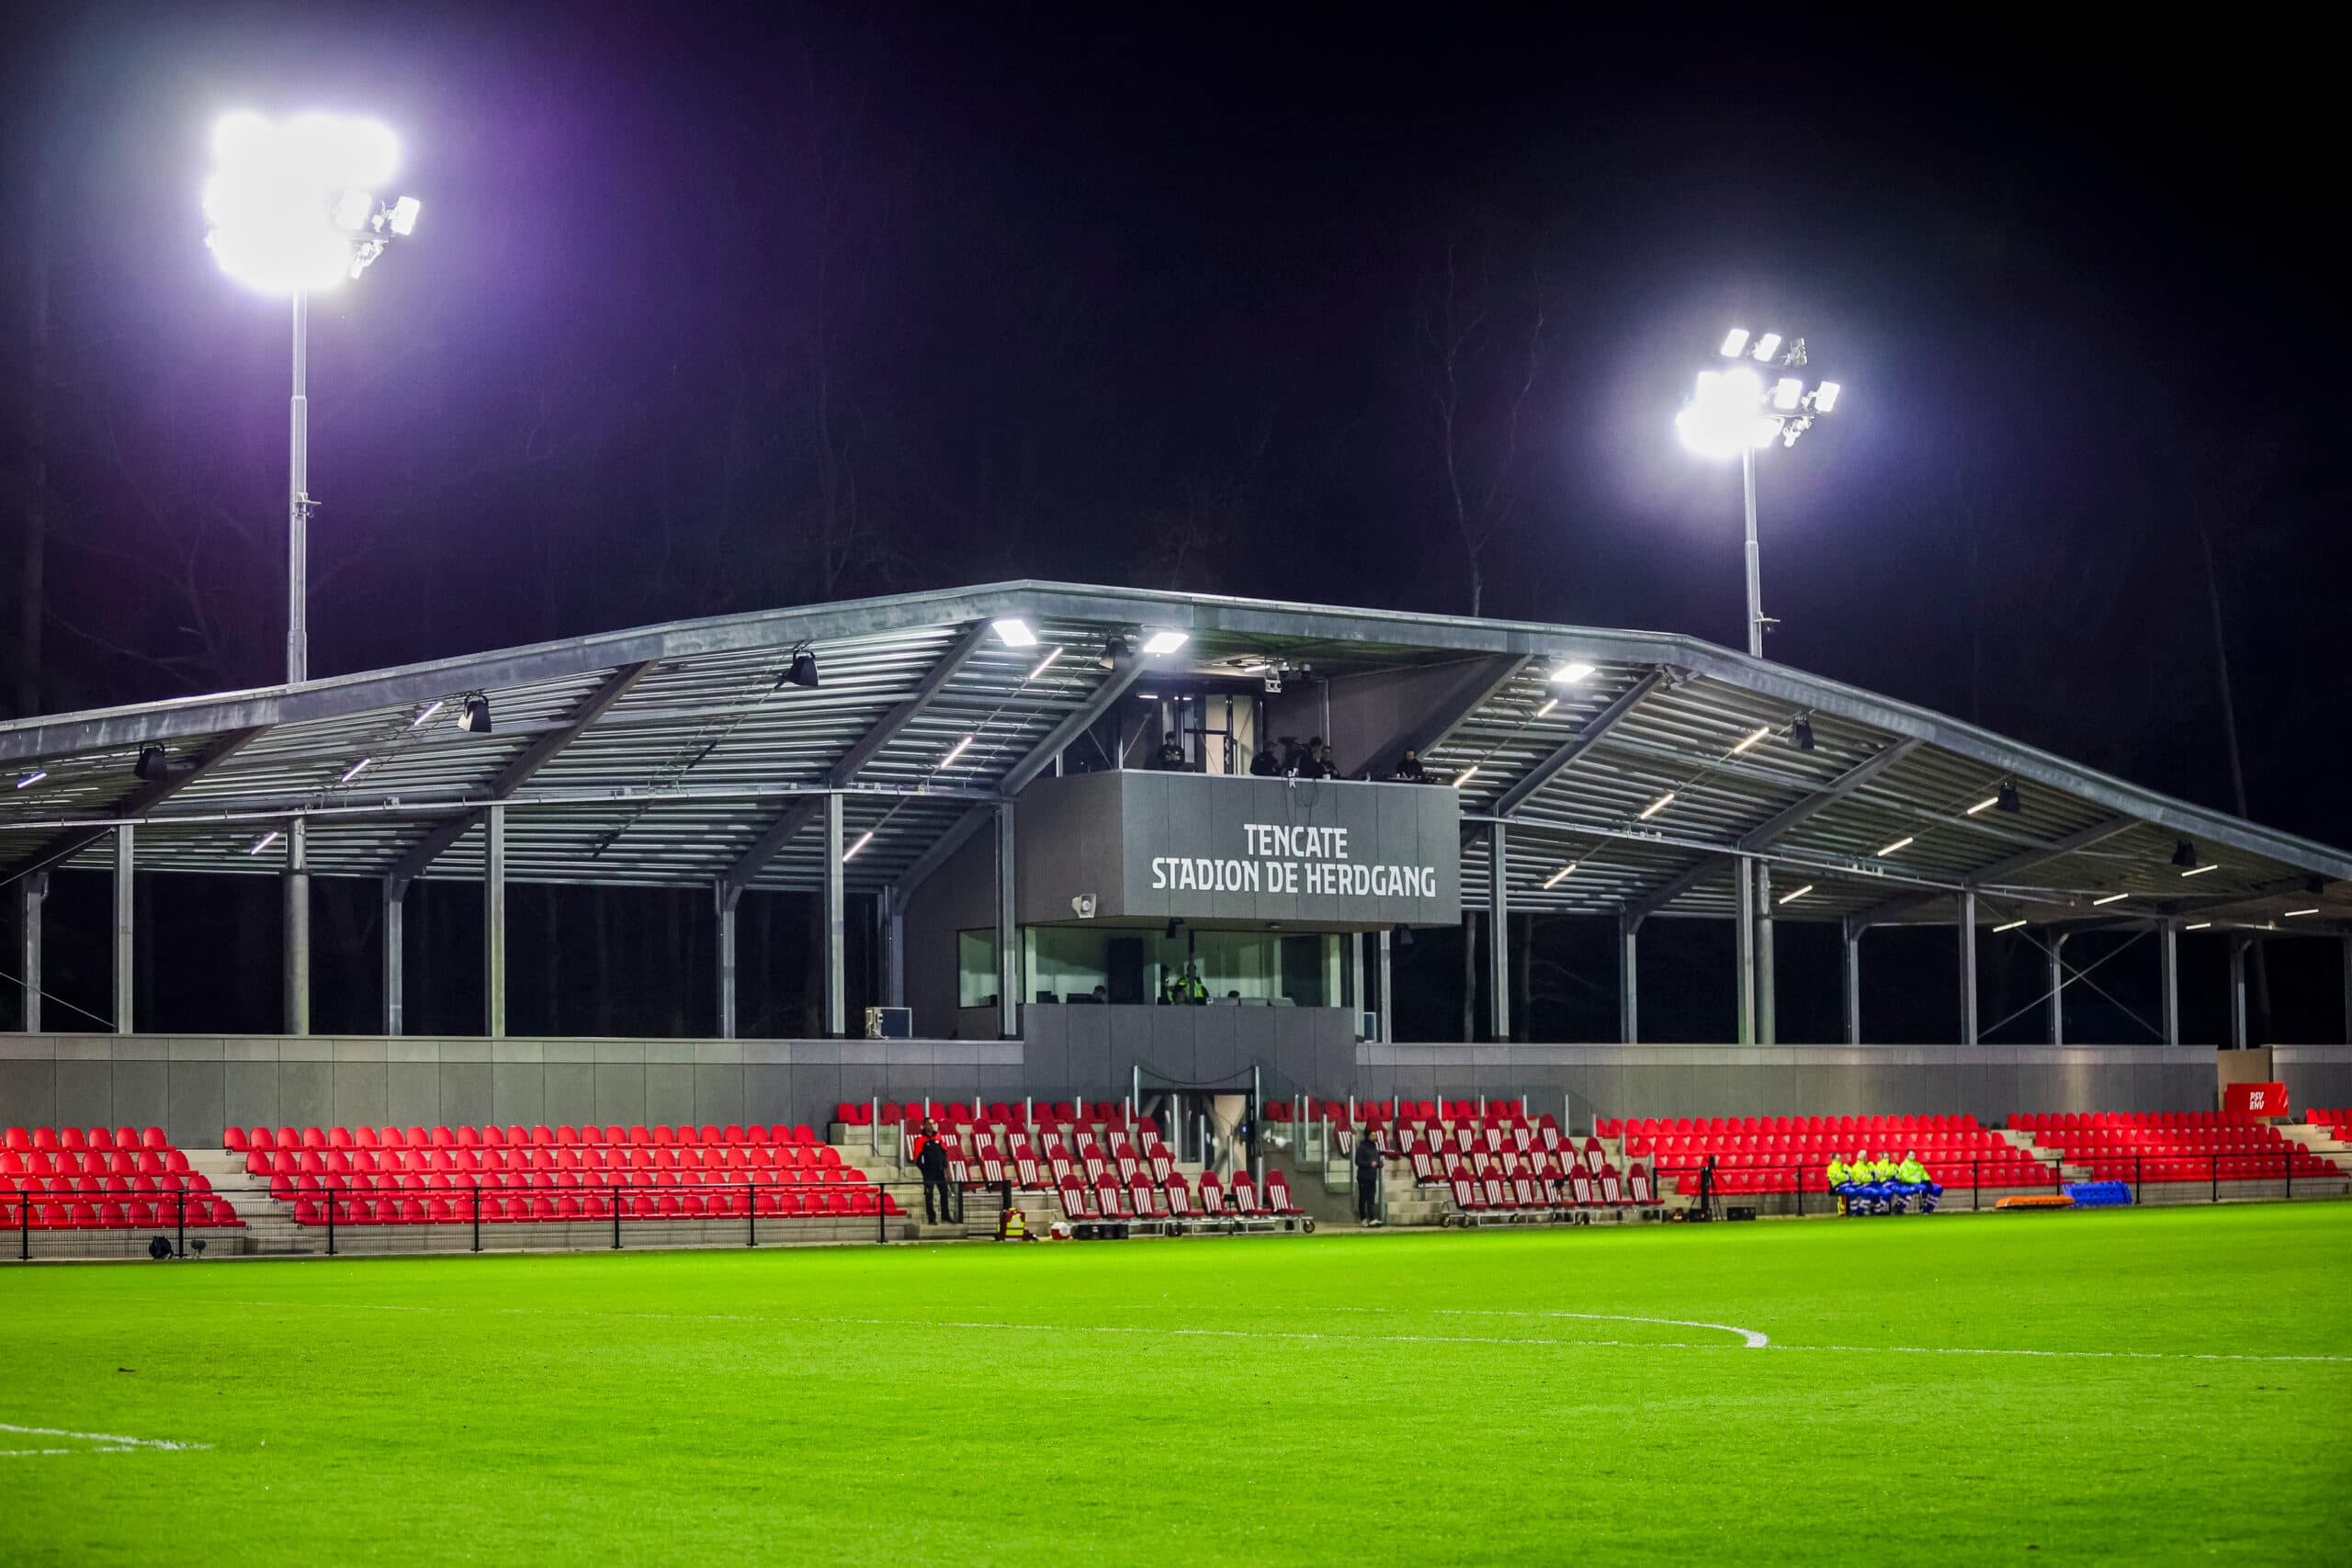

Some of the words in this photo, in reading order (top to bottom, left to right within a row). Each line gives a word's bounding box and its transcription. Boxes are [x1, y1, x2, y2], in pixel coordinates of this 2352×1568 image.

[1243, 823, 1348, 859] TENCATE
[1152, 857, 1259, 892] STADION
[1265, 861, 1298, 894] DE
[1305, 862, 1436, 897] HERDGANG
[2250, 1091, 2264, 1100] PSV
